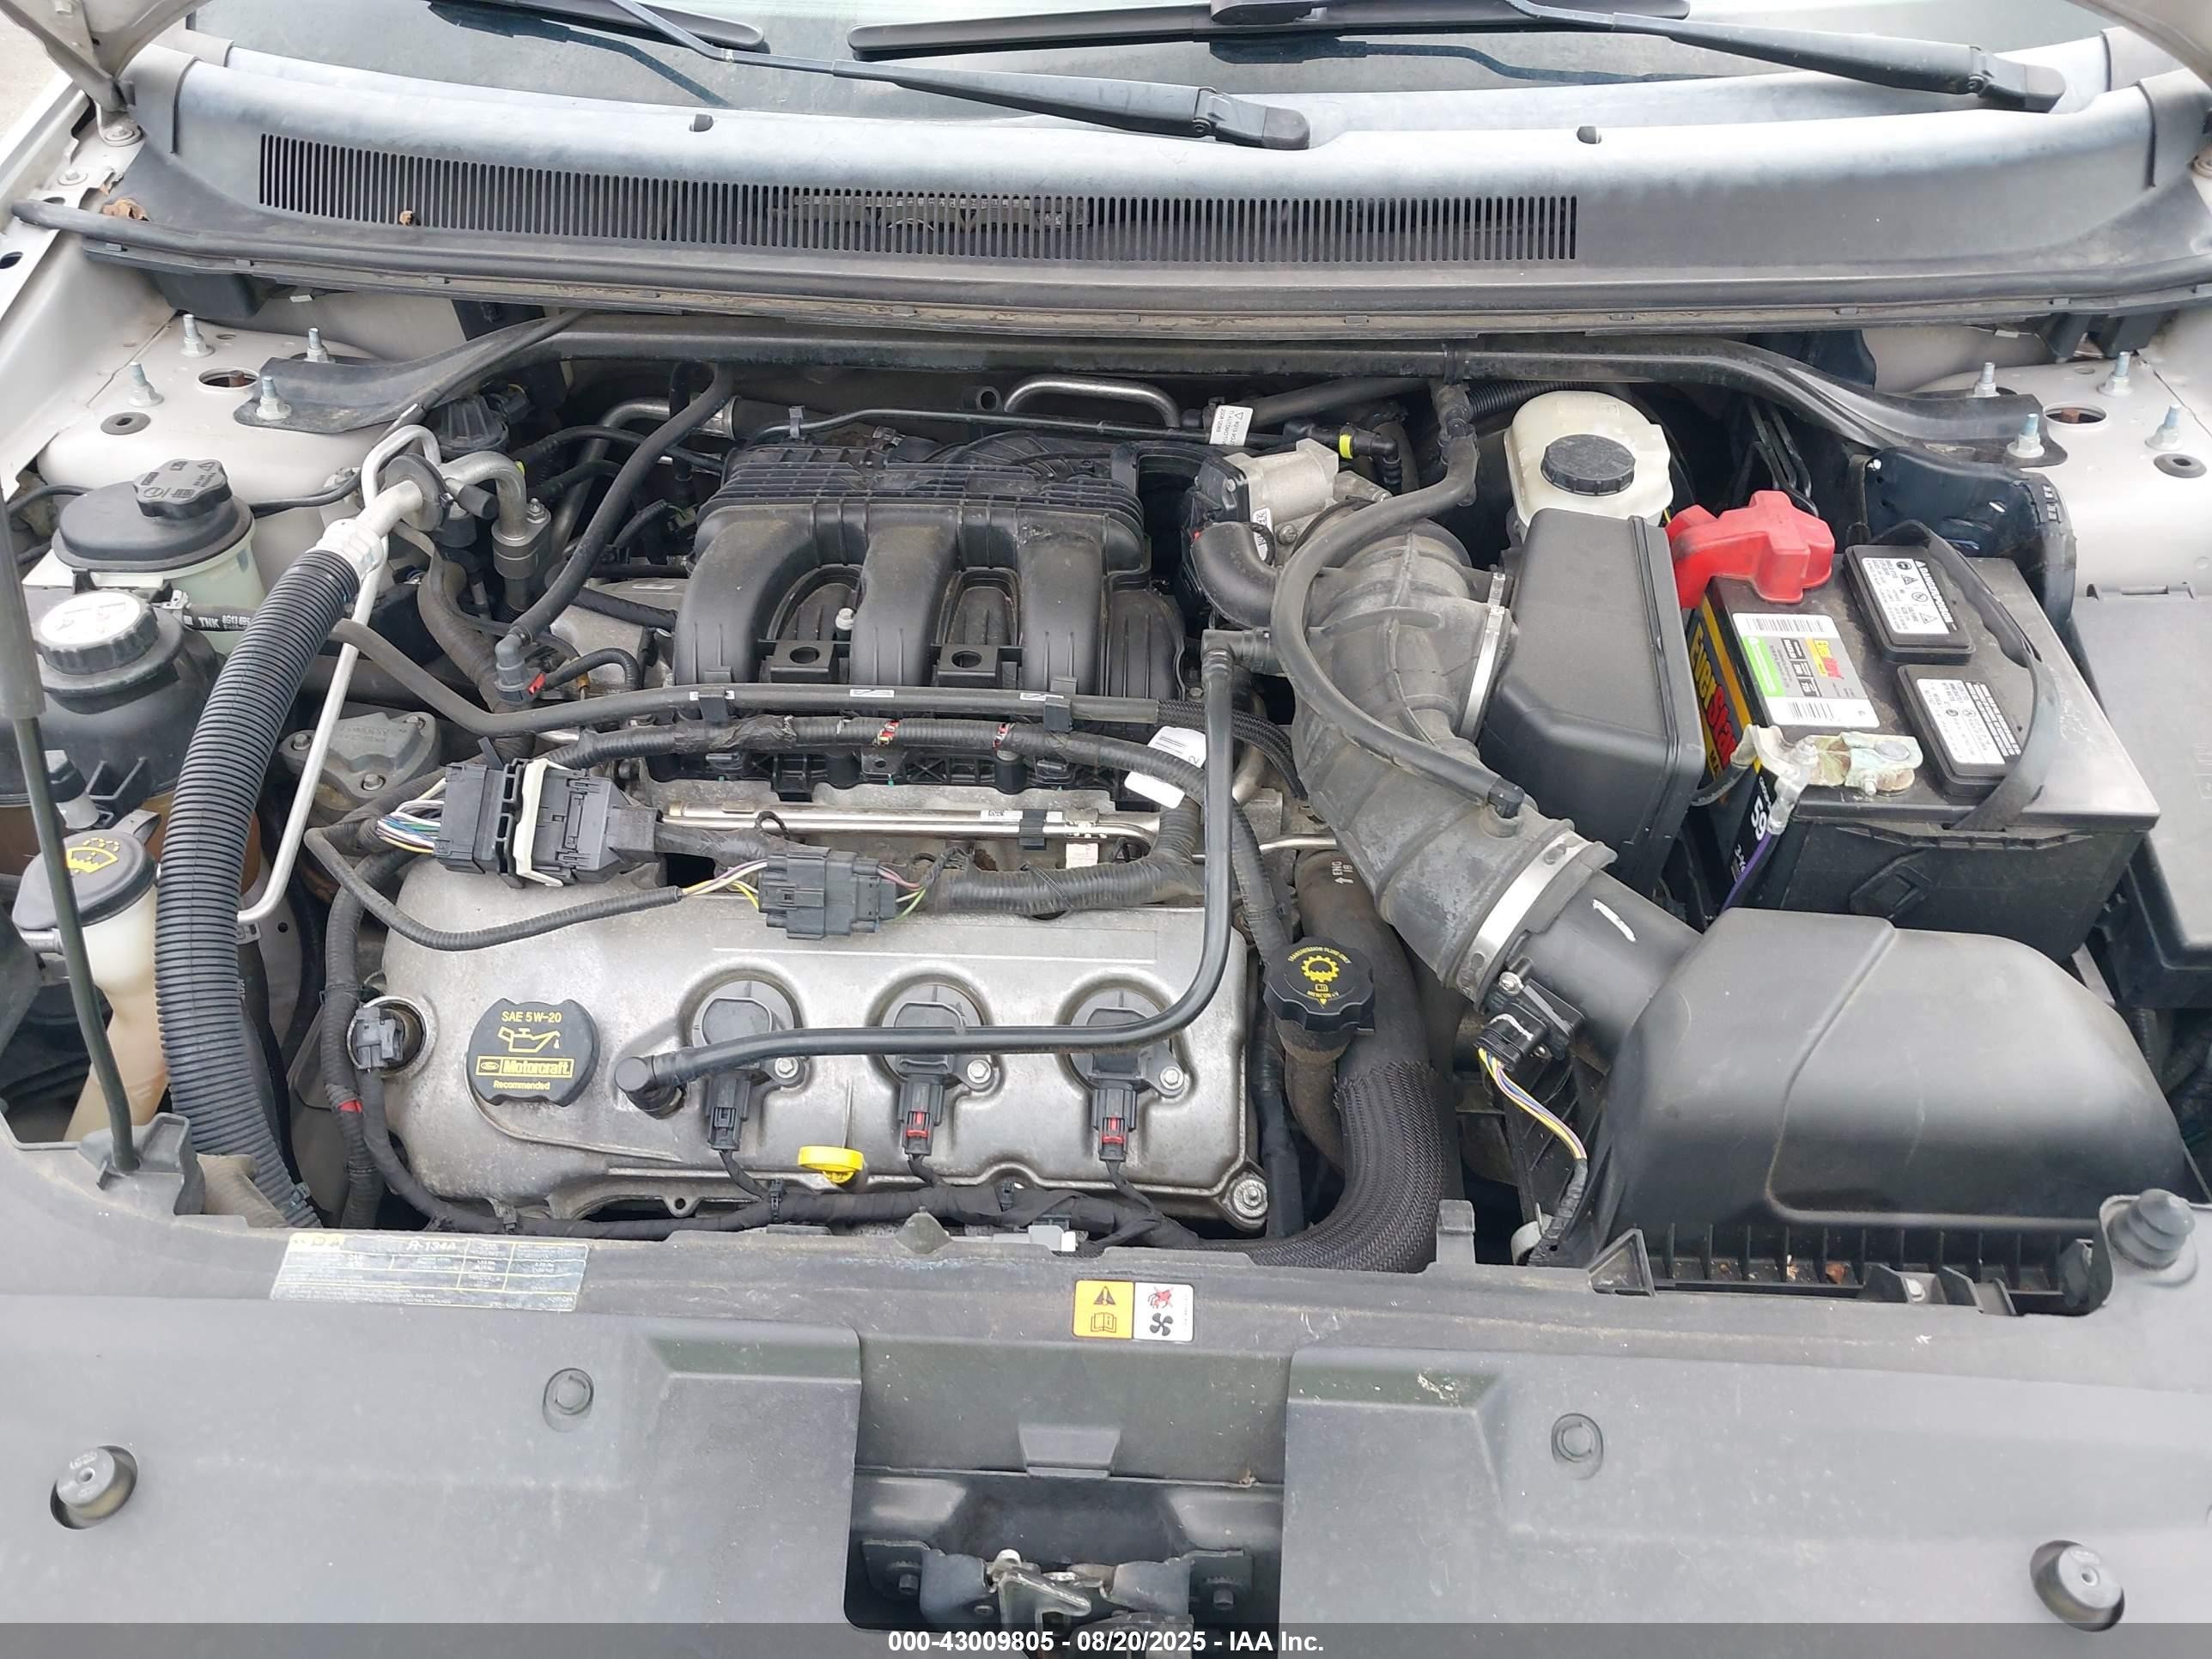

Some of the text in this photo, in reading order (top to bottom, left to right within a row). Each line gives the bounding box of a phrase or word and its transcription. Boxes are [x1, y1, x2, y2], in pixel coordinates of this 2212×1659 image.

[501, 1011, 562, 1024] SAE 5W-20
[493, 1079, 551, 1091] Recommended
